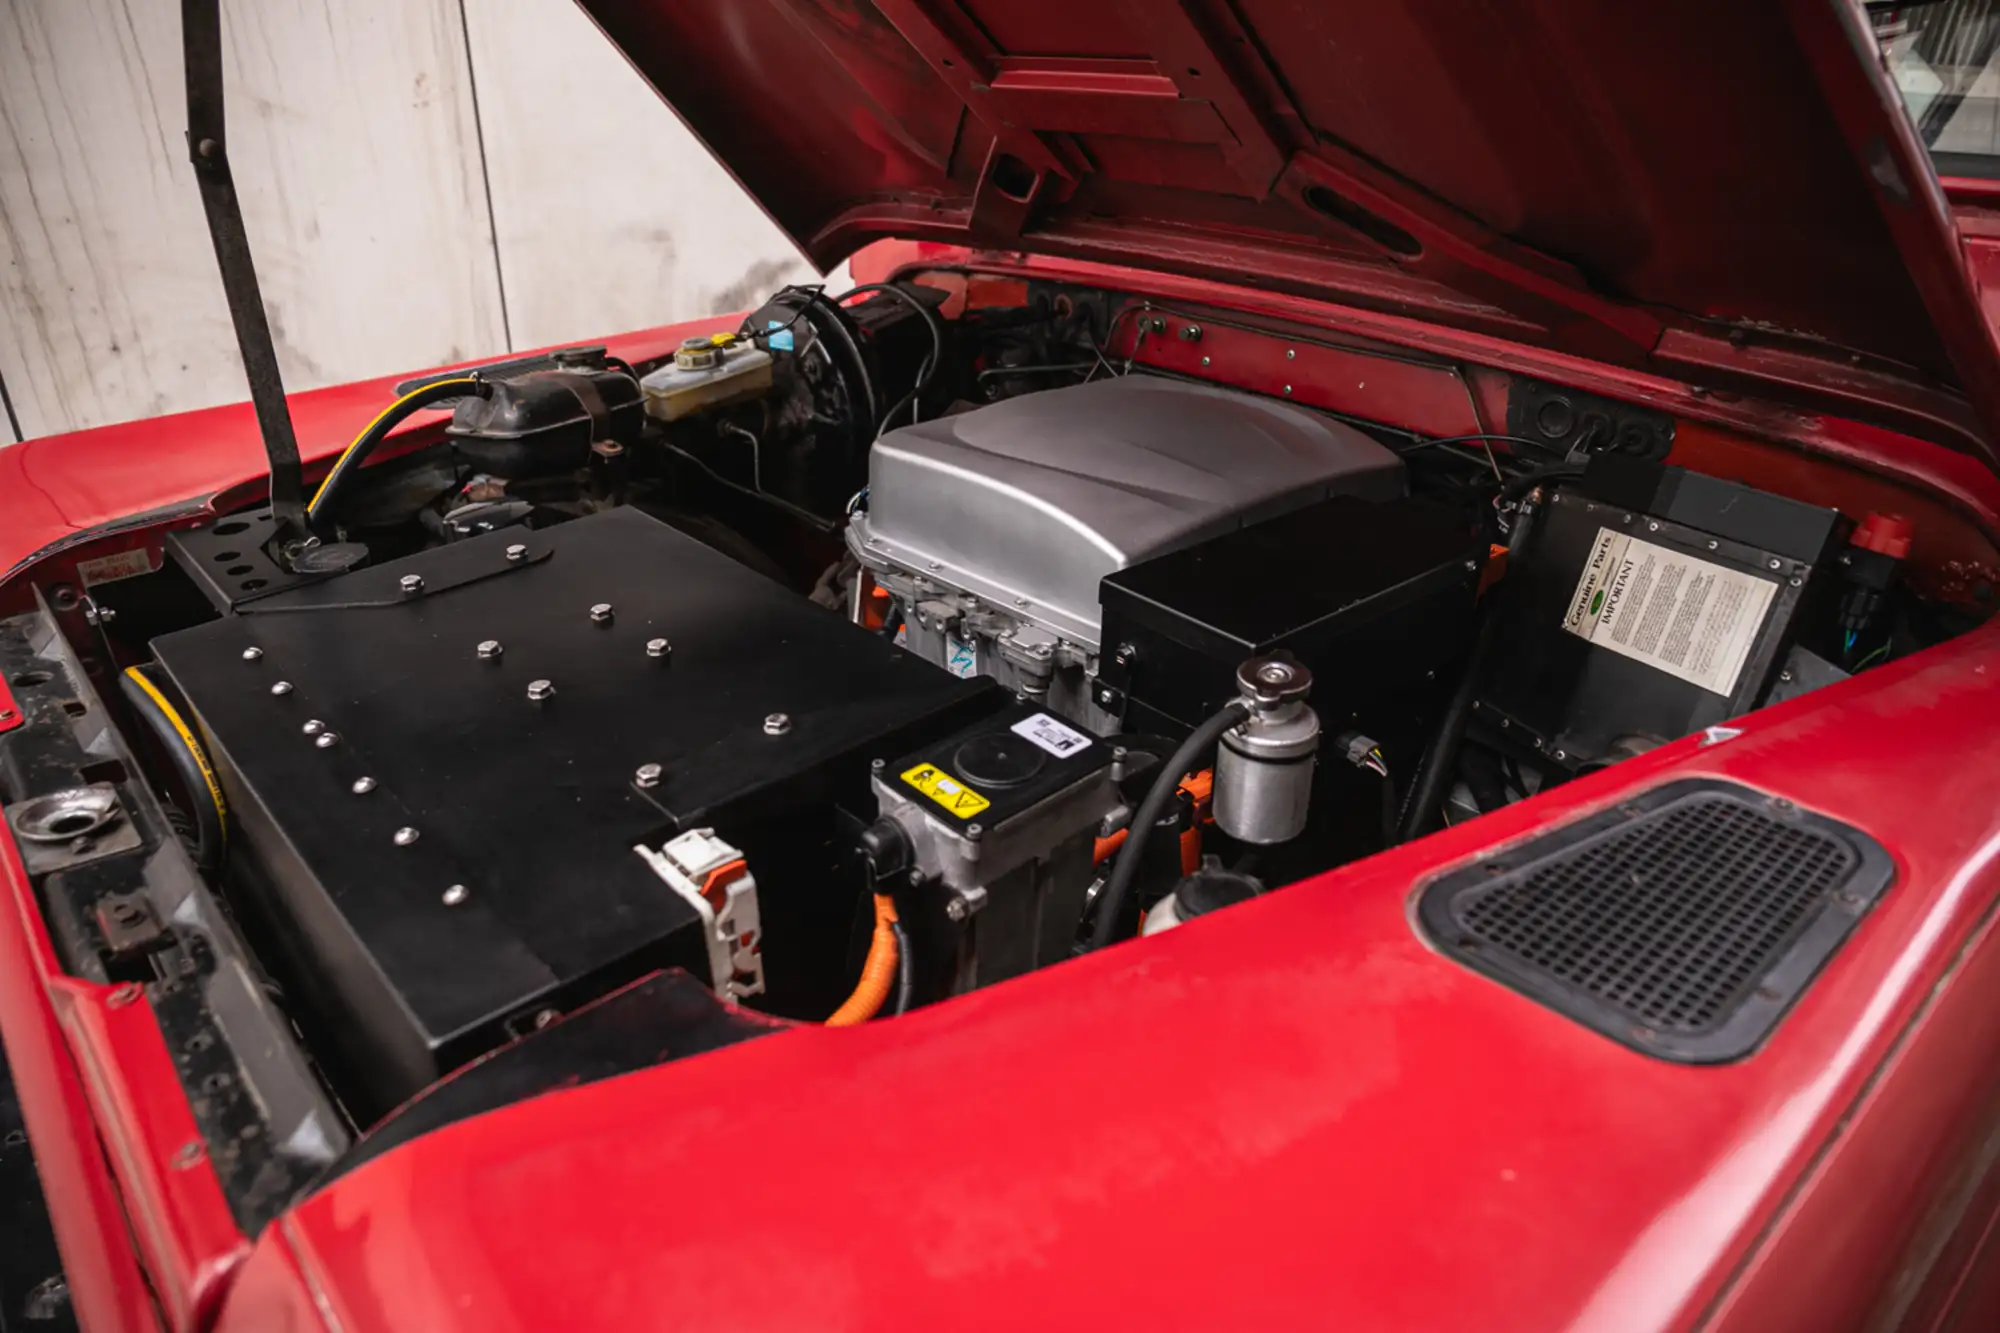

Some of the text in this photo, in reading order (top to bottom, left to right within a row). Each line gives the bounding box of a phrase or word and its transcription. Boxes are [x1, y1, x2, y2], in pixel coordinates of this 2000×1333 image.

[1571, 574, 1596, 627] Genuine
[1593, 536, 1612, 570] Parts
[1601, 559, 1634, 625] IMPORTANT
